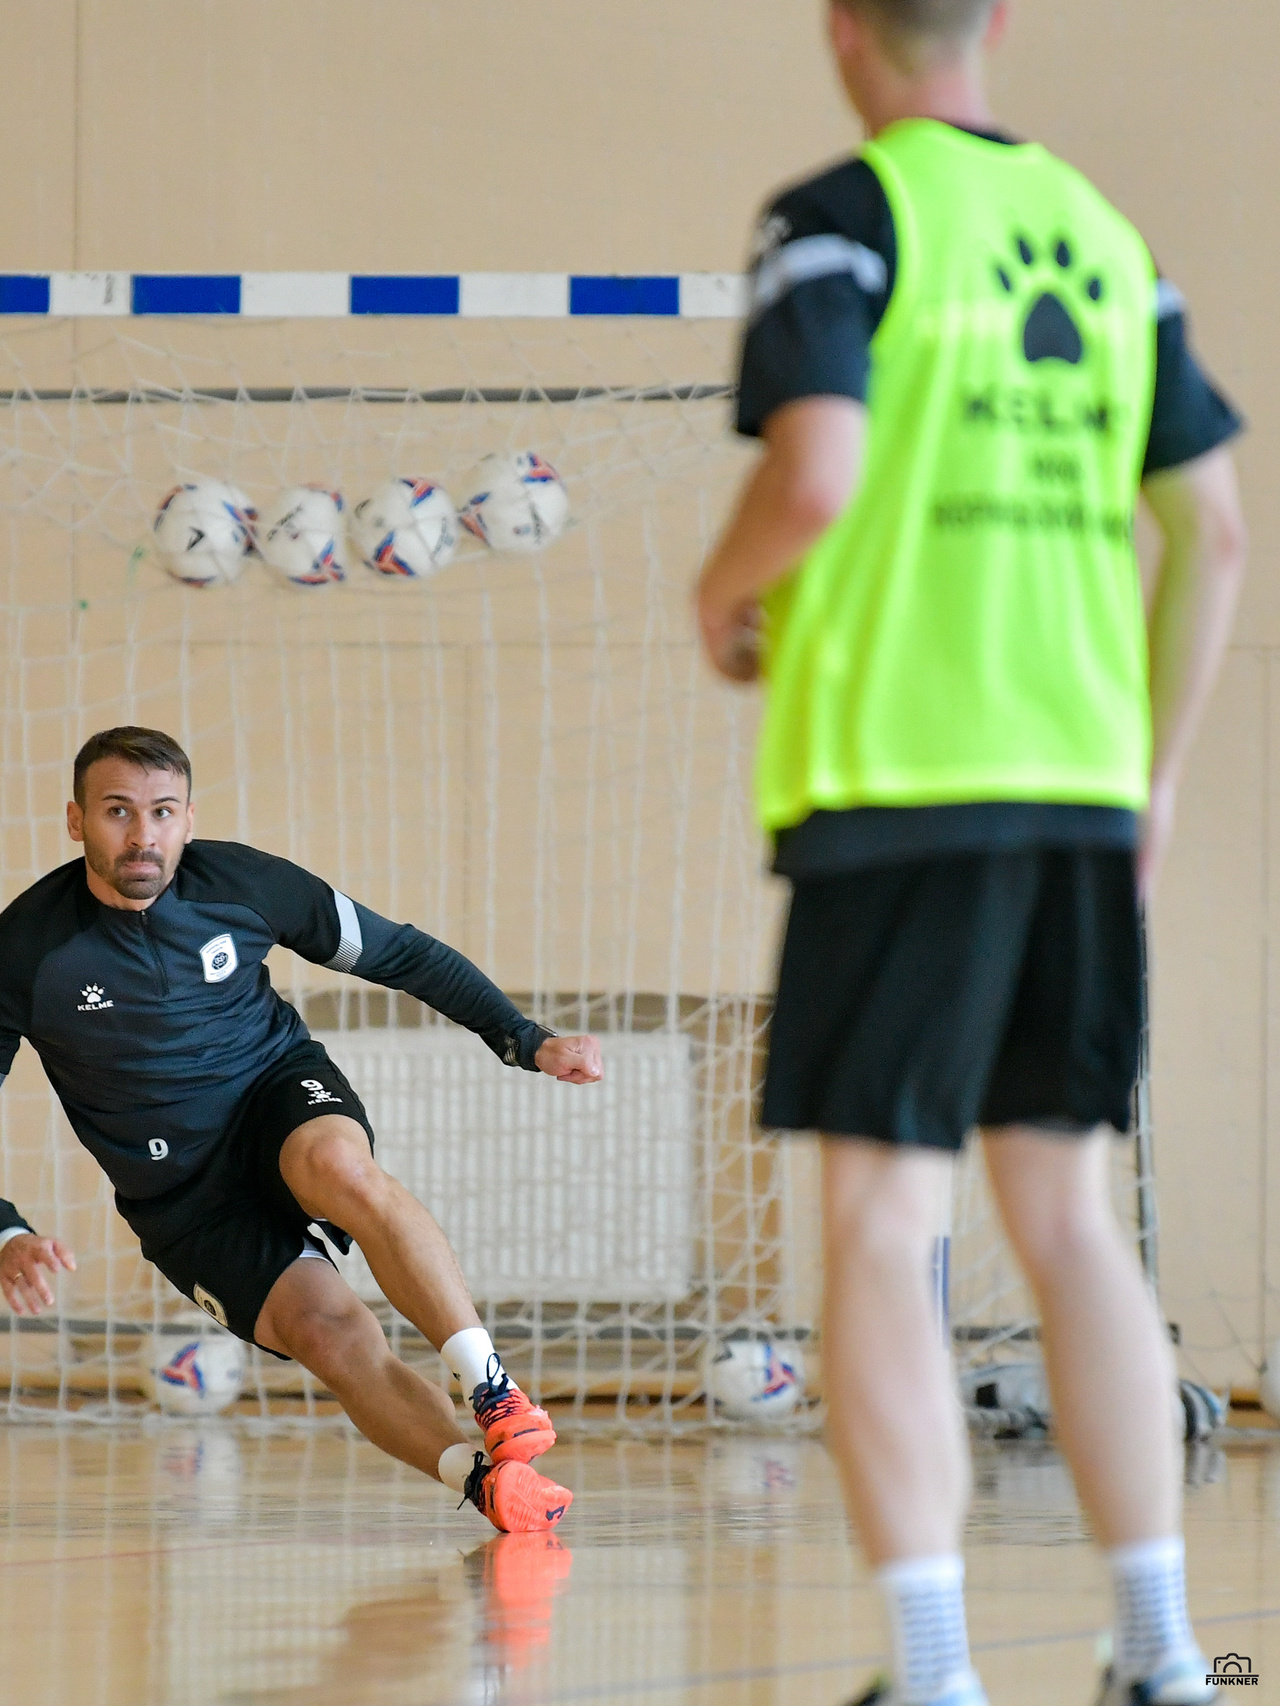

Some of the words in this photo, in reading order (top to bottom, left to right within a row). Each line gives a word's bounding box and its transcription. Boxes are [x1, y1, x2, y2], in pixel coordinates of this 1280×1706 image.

[76, 999, 115, 1012] KELME
[300, 1079, 324, 1091] 9
[148, 1137, 169, 1161] 9
